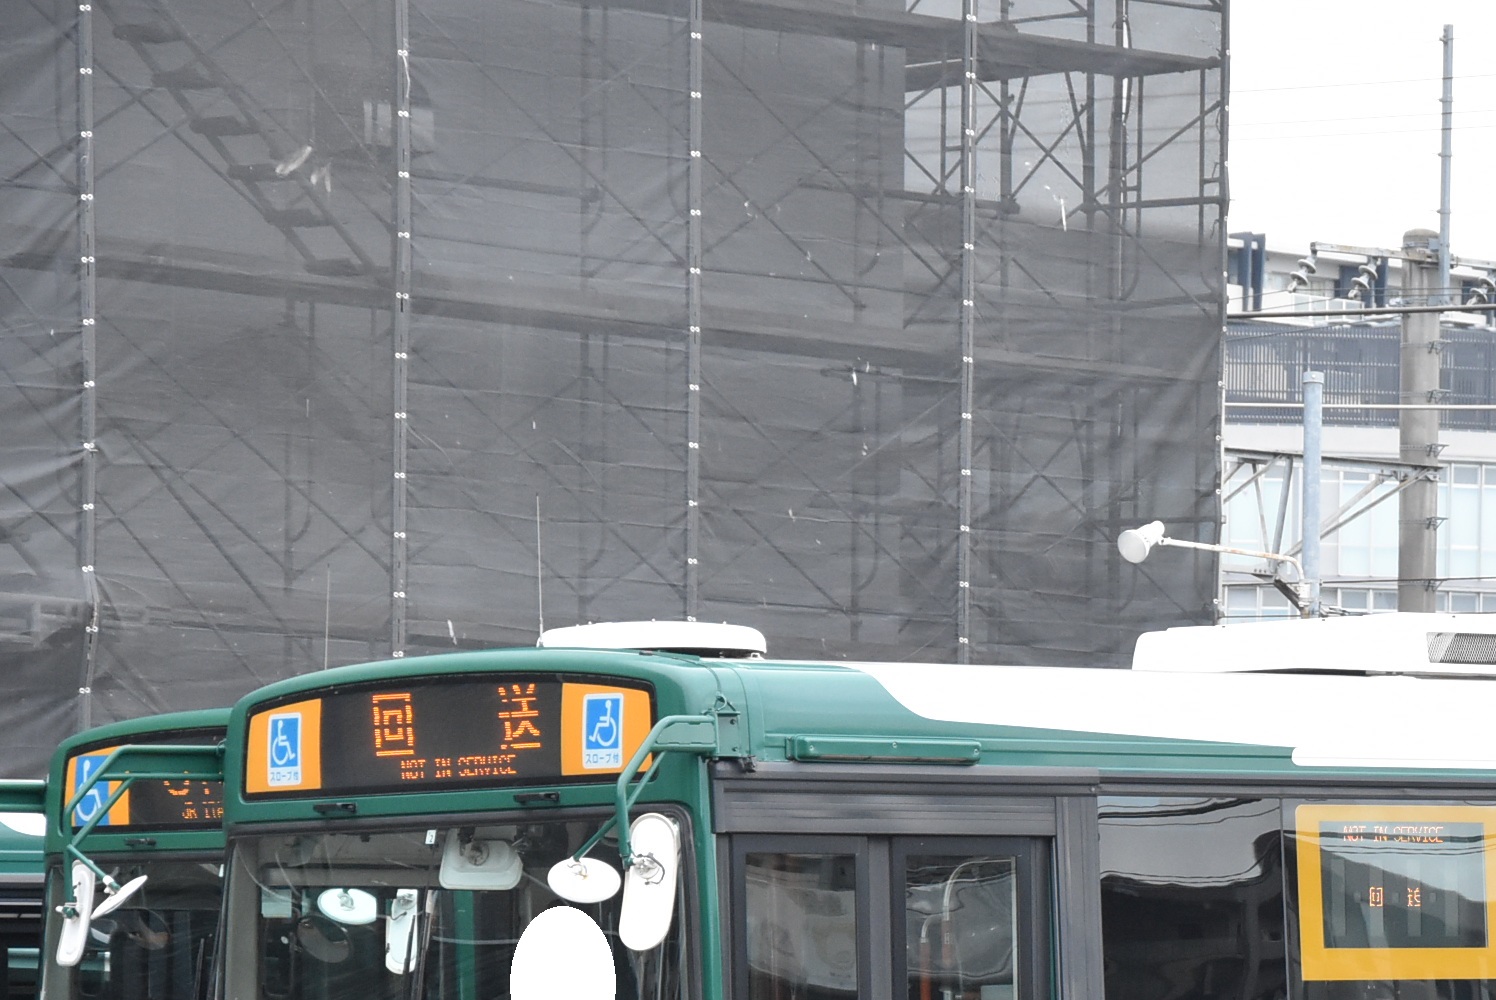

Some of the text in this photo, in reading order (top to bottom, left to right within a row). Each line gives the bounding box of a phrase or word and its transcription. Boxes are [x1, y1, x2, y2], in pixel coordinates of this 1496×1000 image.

[372, 684, 541, 757] 回送
[401, 754, 517, 780] NOT IN SERVICE
[1343, 825, 1445, 843] NOT IN SERVICE
